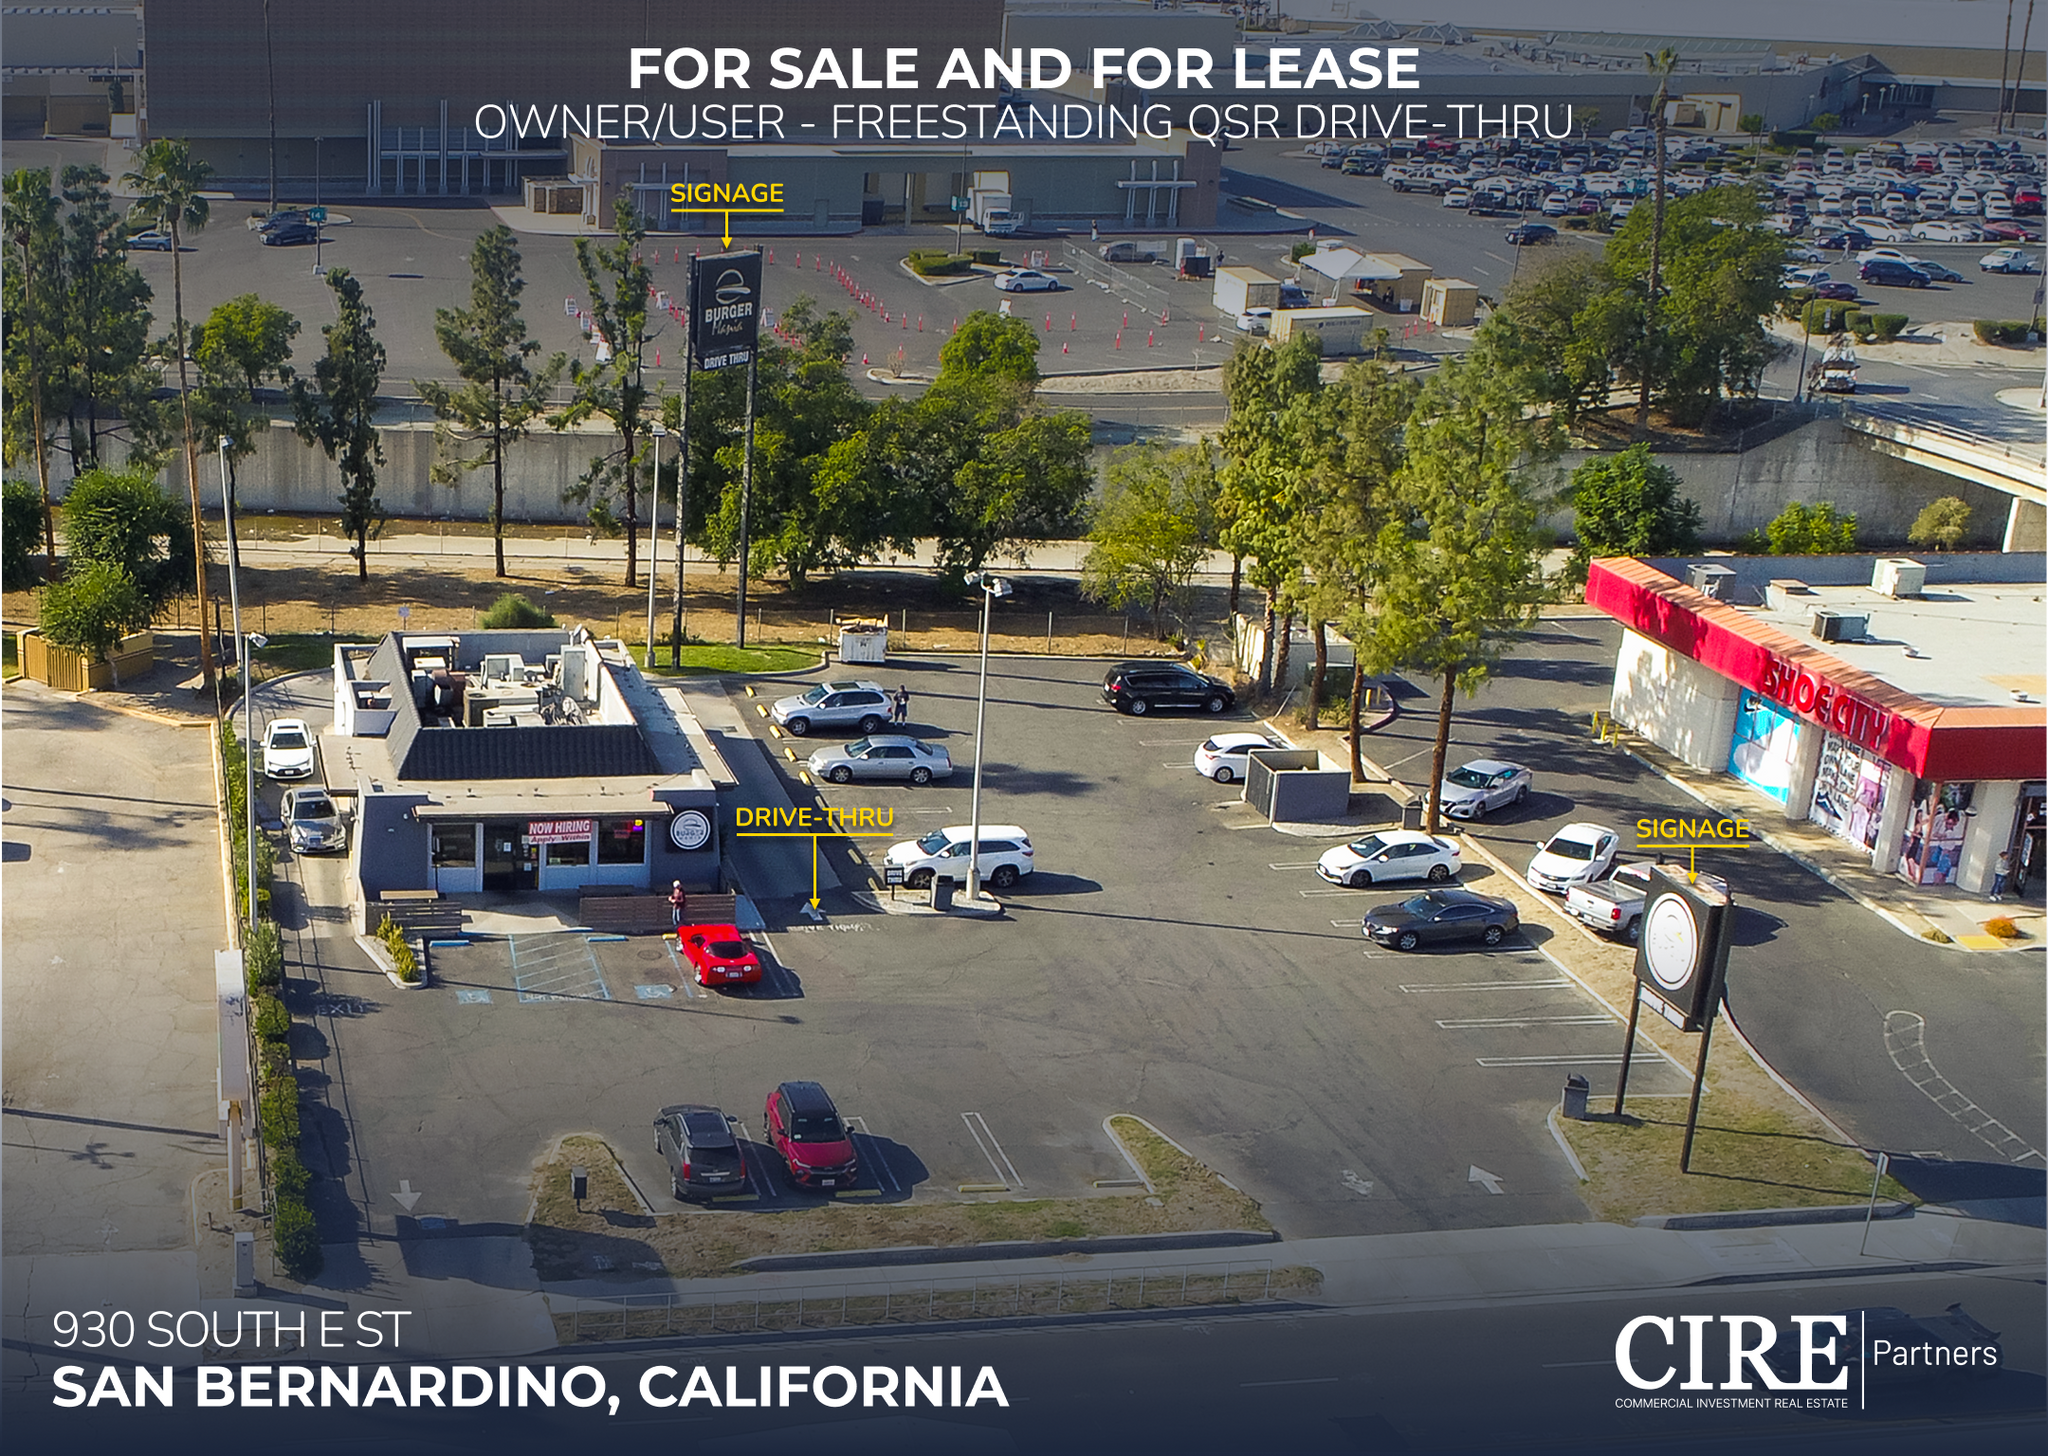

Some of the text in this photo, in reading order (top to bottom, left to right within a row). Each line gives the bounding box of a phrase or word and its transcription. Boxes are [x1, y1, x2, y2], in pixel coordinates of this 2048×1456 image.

[705, 302, 753, 323] BURGER
[704, 351, 749, 370] DRIVE THRU
[1761, 658, 1890, 749] SHOE CITY
[529, 820, 590, 834] NOW HIRING
